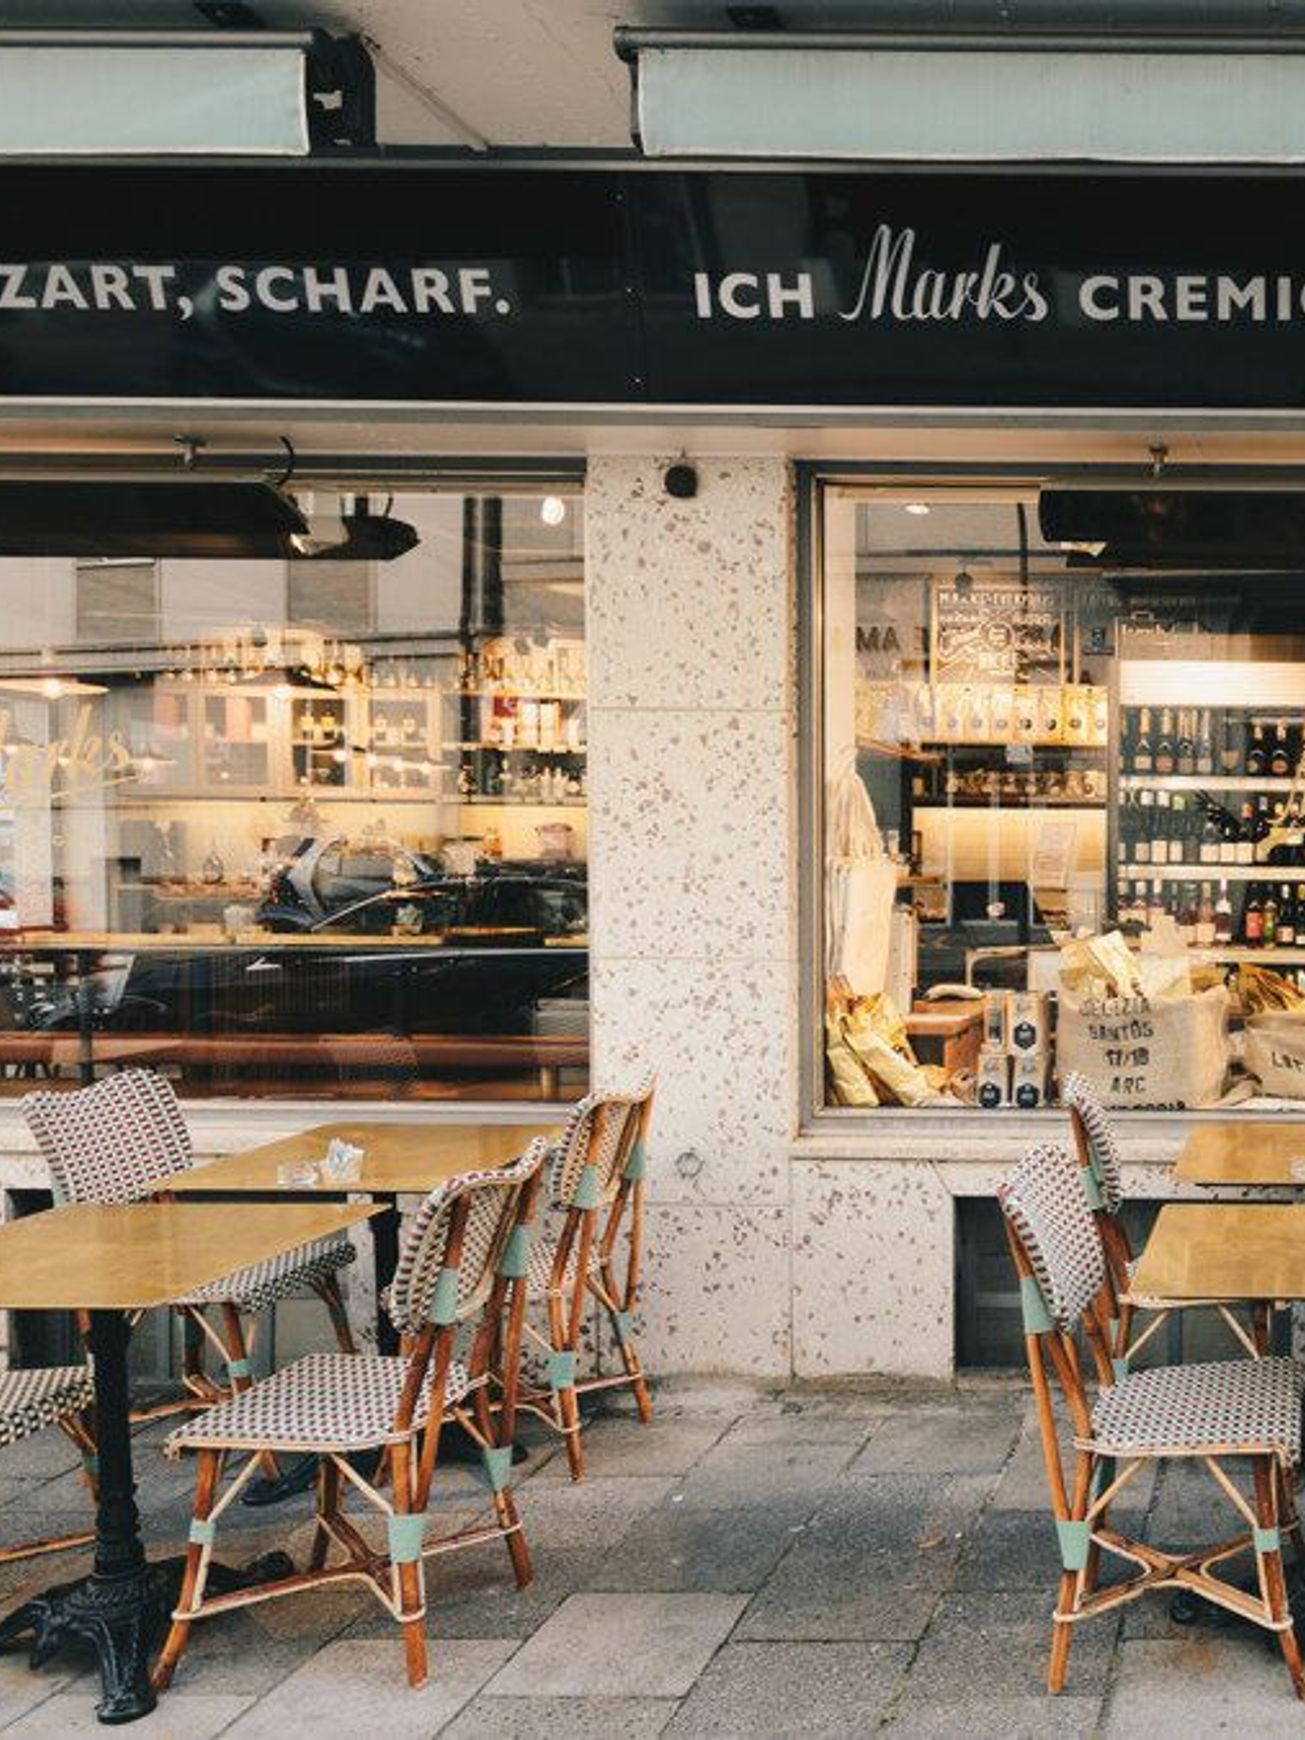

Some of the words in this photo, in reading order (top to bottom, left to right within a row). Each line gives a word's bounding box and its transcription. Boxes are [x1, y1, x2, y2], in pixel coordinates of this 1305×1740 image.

[0, 265, 192, 319] ZART,
[216, 266, 510, 313] SCHARF.
[694, 273, 814, 318] ICH
[838, 224, 1048, 321] Marks
